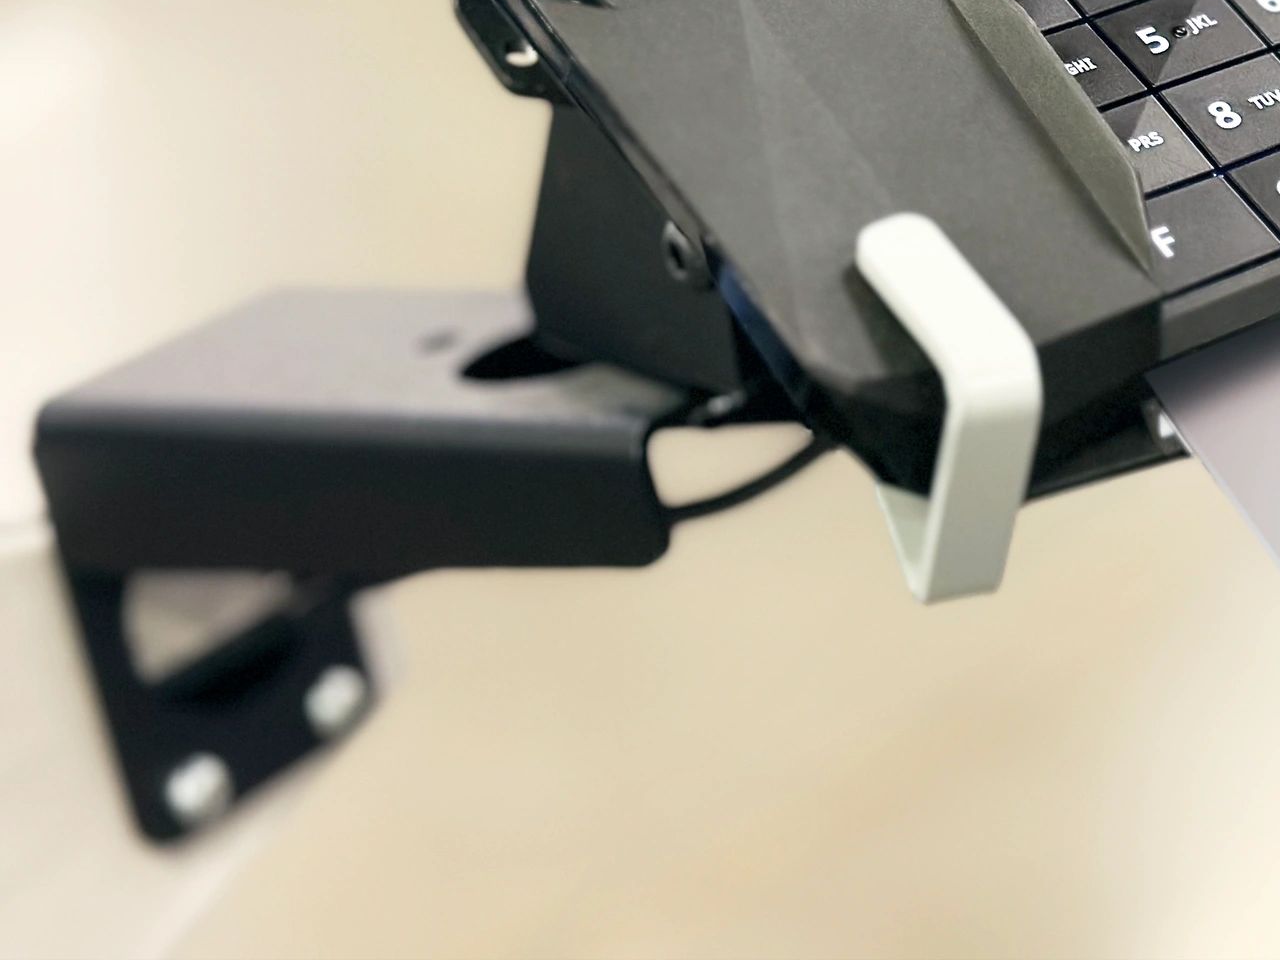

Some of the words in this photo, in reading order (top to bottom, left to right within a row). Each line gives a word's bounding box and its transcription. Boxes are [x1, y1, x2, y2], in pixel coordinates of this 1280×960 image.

[1135, 26, 1170, 55] 5
[1185, 13, 1219, 36] JKL
[1064, 57, 1098, 77] GHI
[1207, 100, 1243, 130] 8
[1127, 131, 1165, 153] PRS
[1150, 225, 1176, 259] F
